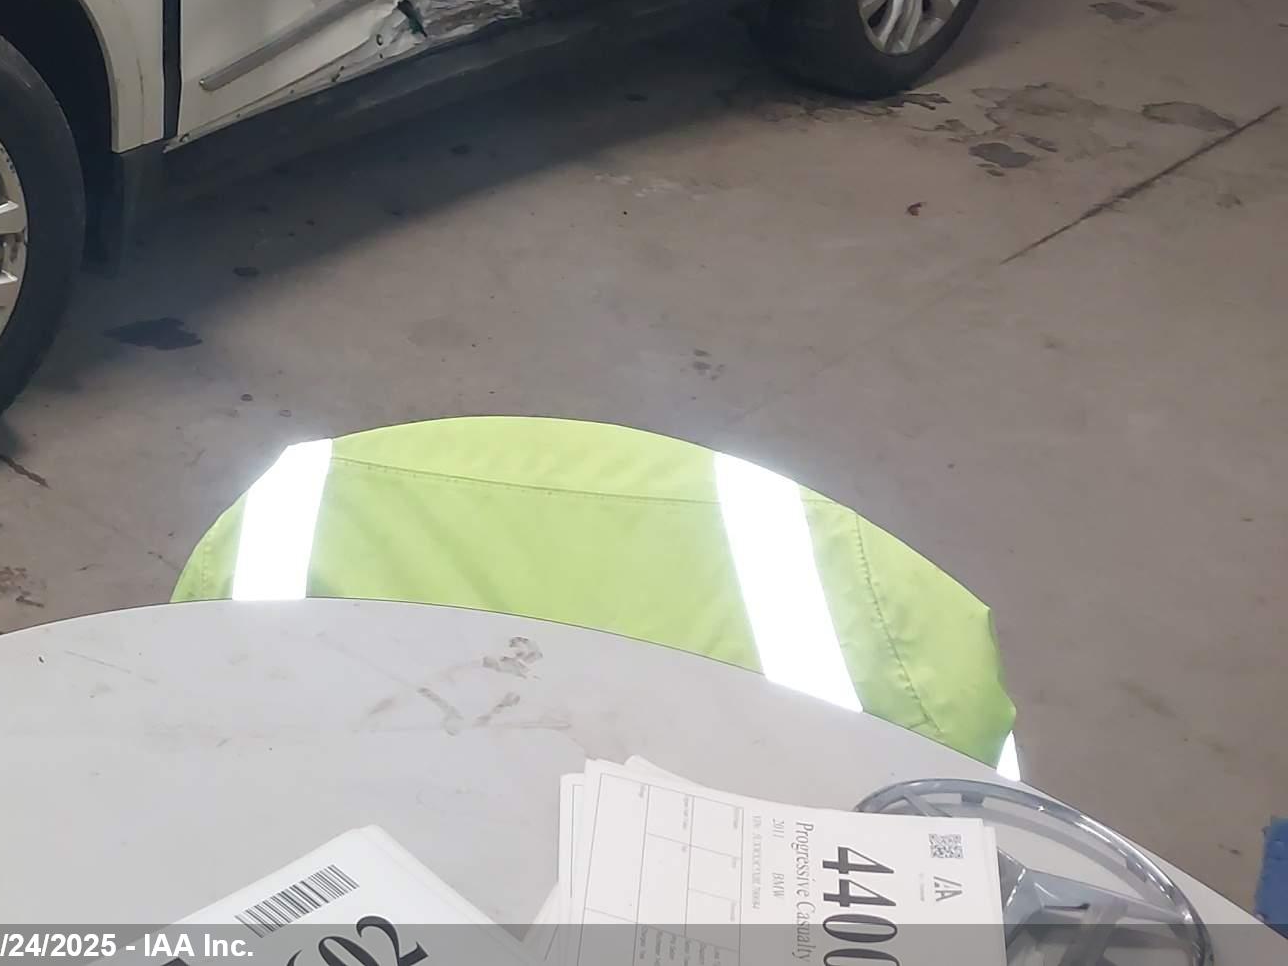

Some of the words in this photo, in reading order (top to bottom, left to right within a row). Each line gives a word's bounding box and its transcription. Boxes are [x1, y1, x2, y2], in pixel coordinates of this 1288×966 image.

[772, 872, 785, 900] BMW
[790, 821, 814, 899] Progressive
[792, 901, 816, 963] Casualty
